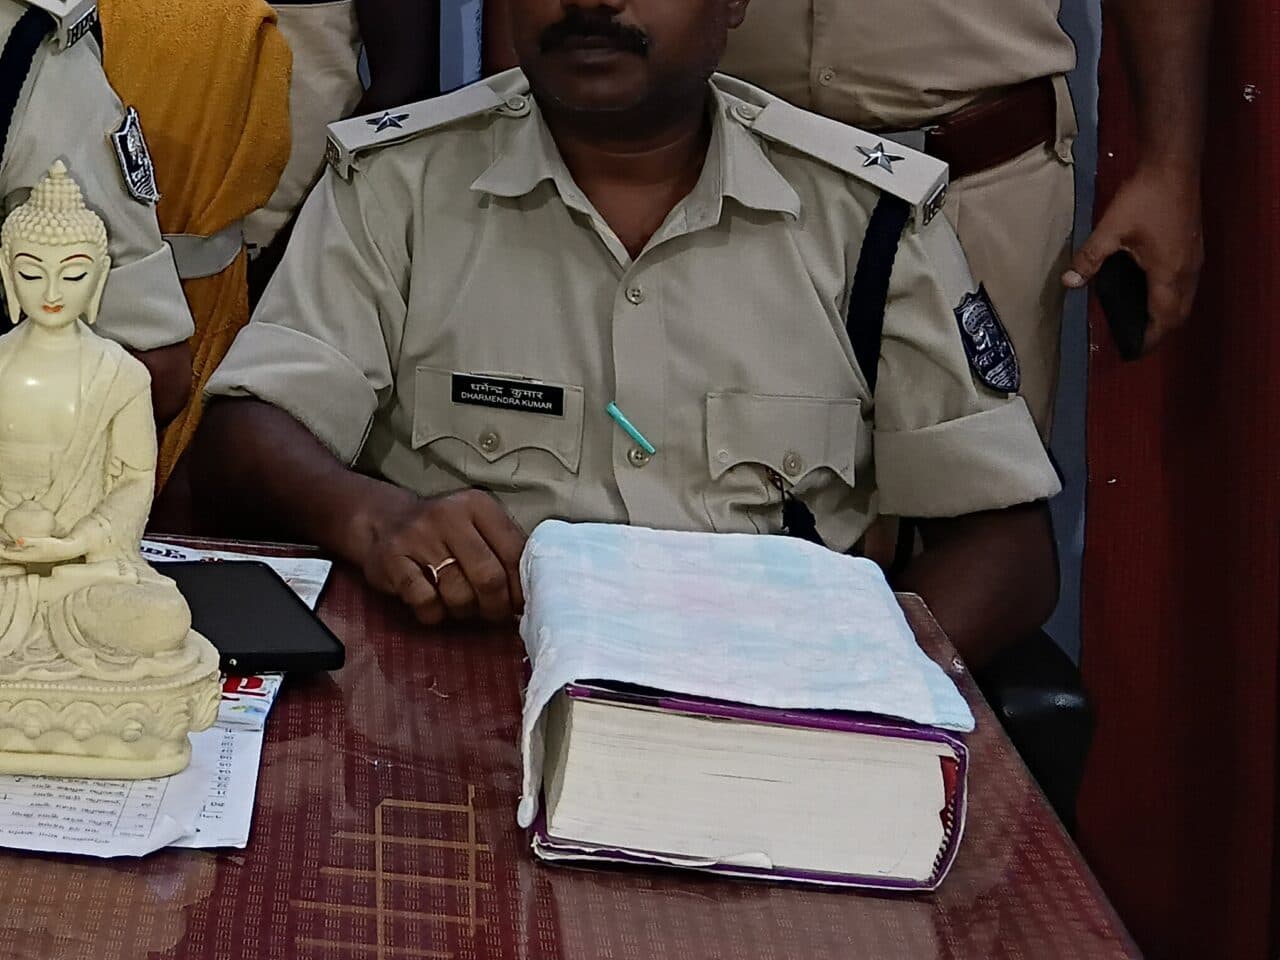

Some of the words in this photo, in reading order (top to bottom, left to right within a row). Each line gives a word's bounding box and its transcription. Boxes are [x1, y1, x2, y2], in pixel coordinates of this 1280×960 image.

[461, 391, 520, 406] DHARMENDRA
[521, 399, 552, 410] KUMAR
[511, 387, 544, 400] कुमार
